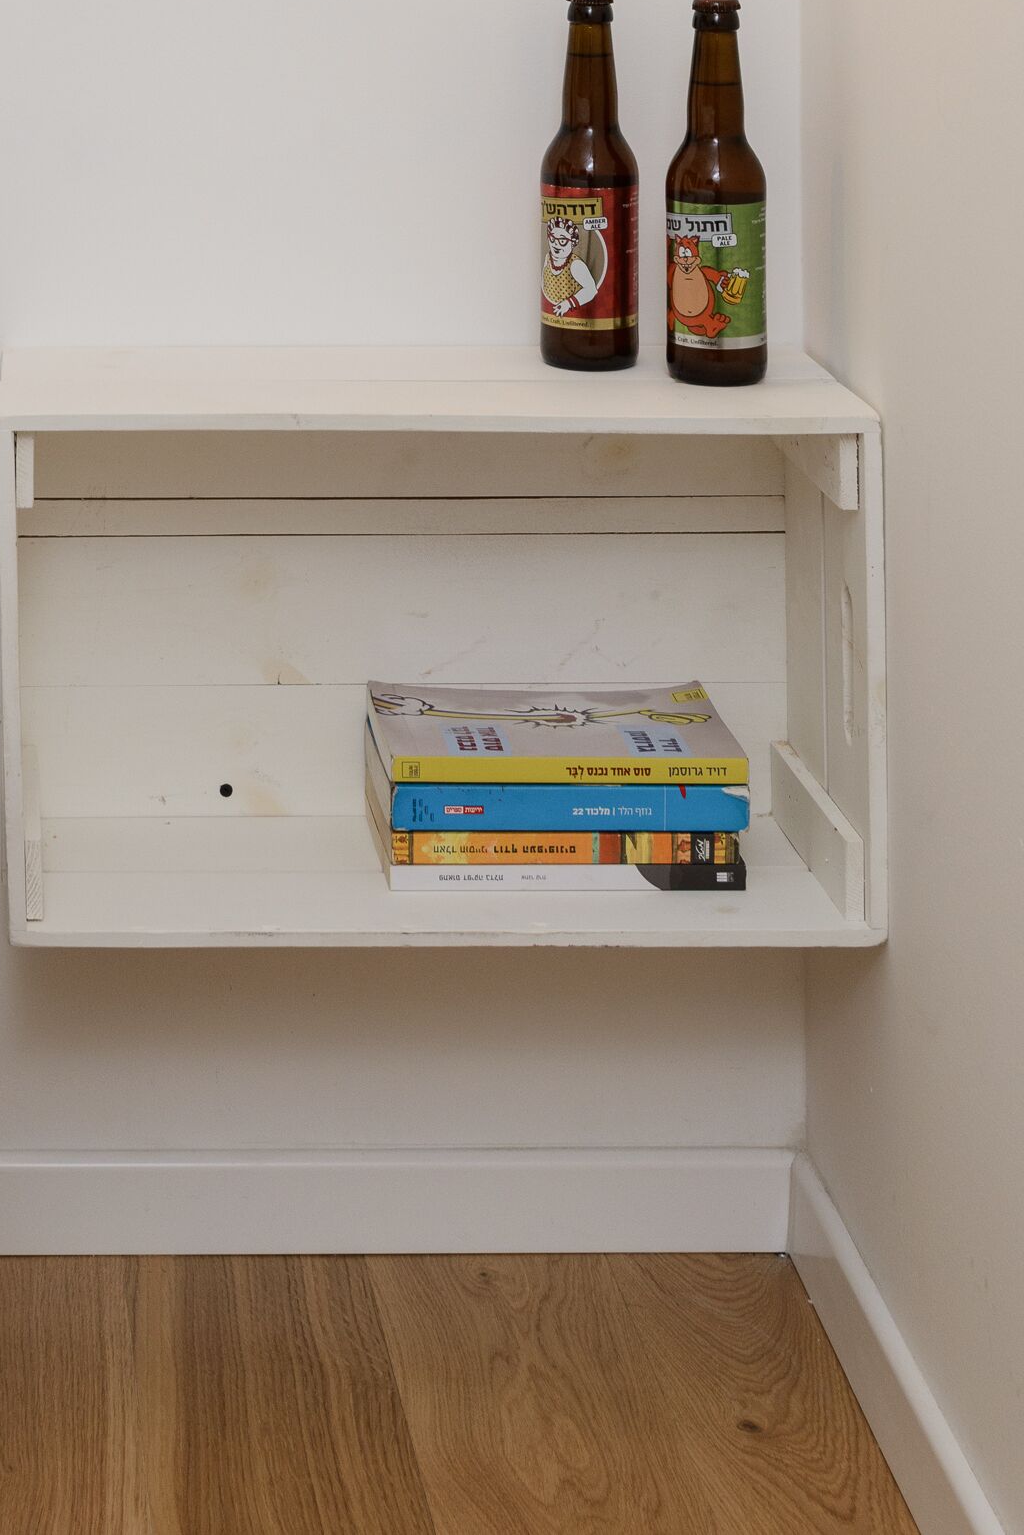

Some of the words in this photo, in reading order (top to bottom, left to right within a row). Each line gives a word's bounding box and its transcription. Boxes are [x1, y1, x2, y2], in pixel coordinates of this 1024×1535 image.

[685, 217, 728, 233] חתול
[624, 731, 656, 752] גרוסמן
[658, 738, 683, 752] דויד
[587, 767, 608, 776] נכנס
[610, 767, 631, 776] אחד
[633, 767, 652, 777] סוס
[668, 766, 704, 777] גרוסמן
[706, 766, 728, 776] דויד
[572, 807, 584, 816] 22
[584, 806, 610, 816] מלכוד
[433, 845, 457, 854] חאלד
[460, 846, 488, 854] חוסייני
[493, 844, 518, 854] רודף
[522, 845, 576, 854] העפיפונים
